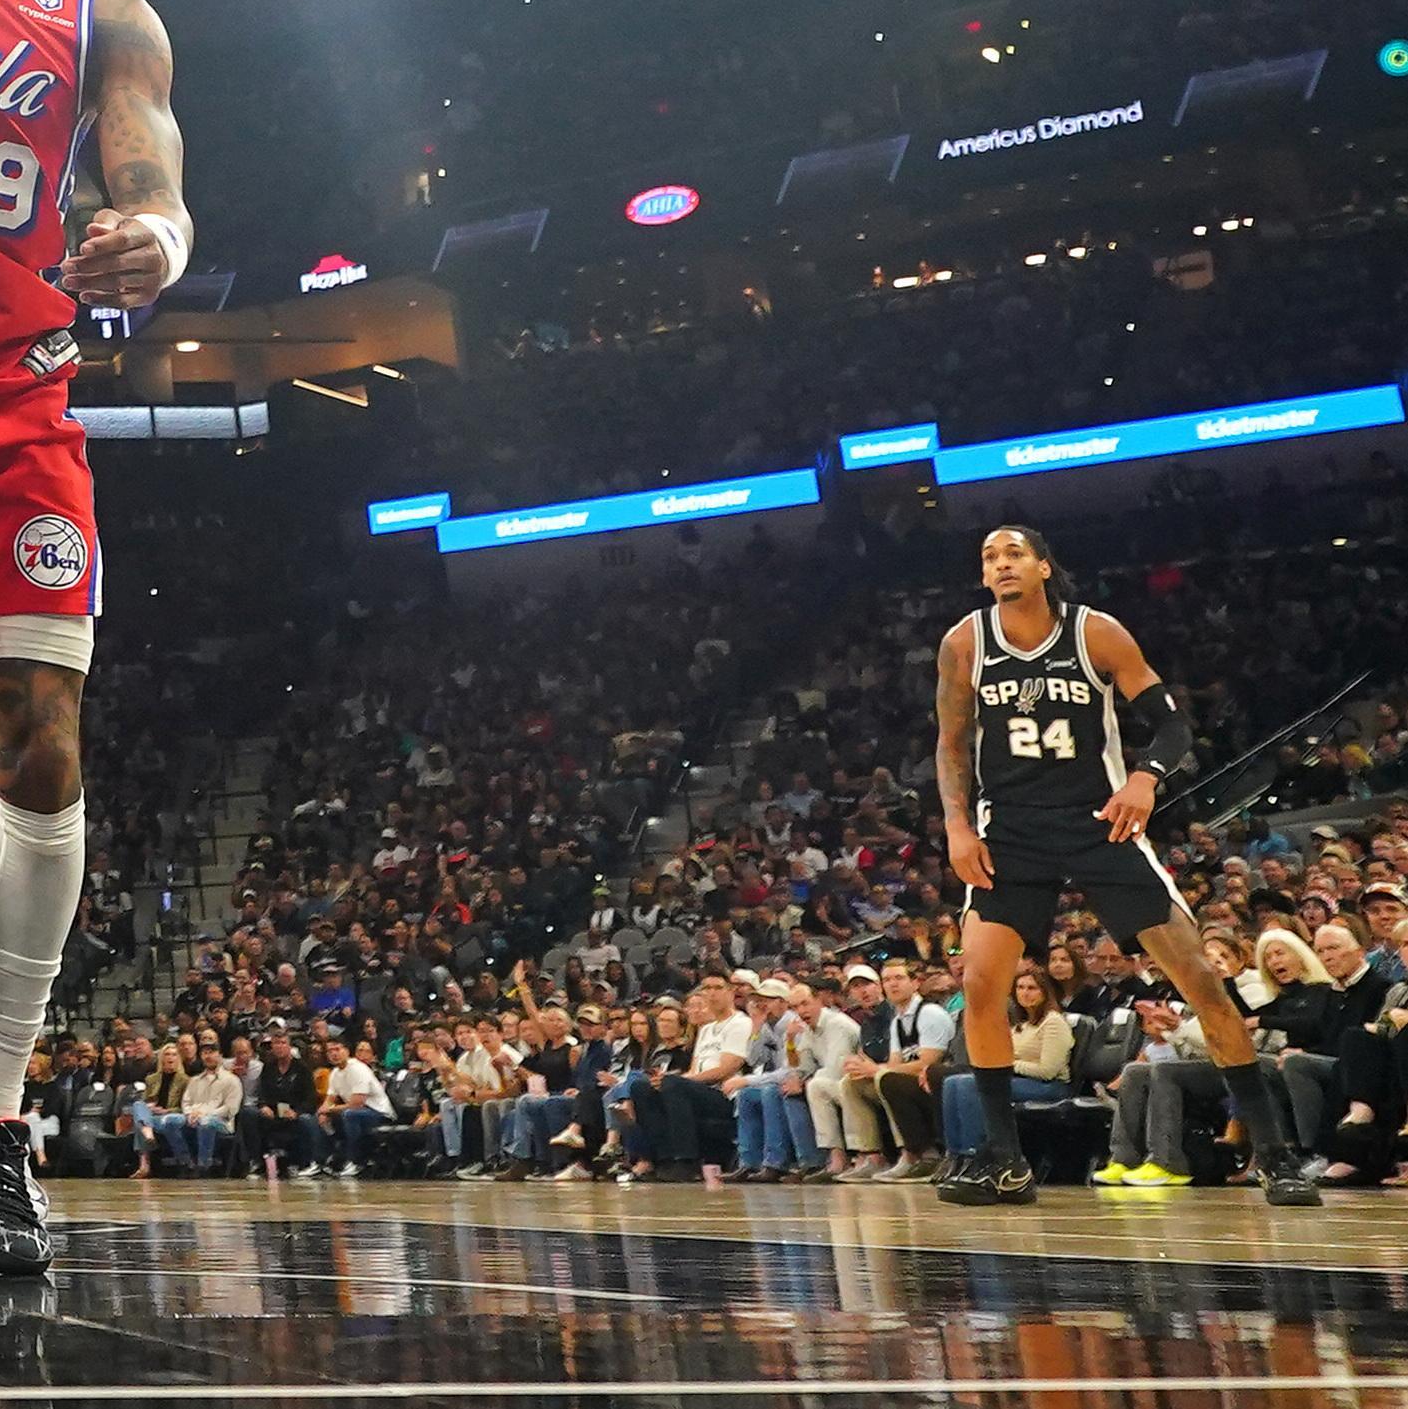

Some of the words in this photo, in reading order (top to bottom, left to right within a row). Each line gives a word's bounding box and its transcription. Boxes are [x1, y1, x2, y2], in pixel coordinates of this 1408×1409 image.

[18, 4, 76, 29] crypto.com
[938, 125, 1037, 160] Americus
[1038, 100, 1144, 140] Diamond
[1196, 409, 1320, 440] ticketmaster
[849, 437, 931, 460] ticketmaster
[1006, 437, 1121, 468] ticketmaster
[495, 511, 590, 538] ticketmaster
[651, 489, 752, 518] ticketmaster
[24, 544, 80, 571] 76ers
[980, 676, 1091, 713] SPURS
[1007, 716, 1076, 760] 24
